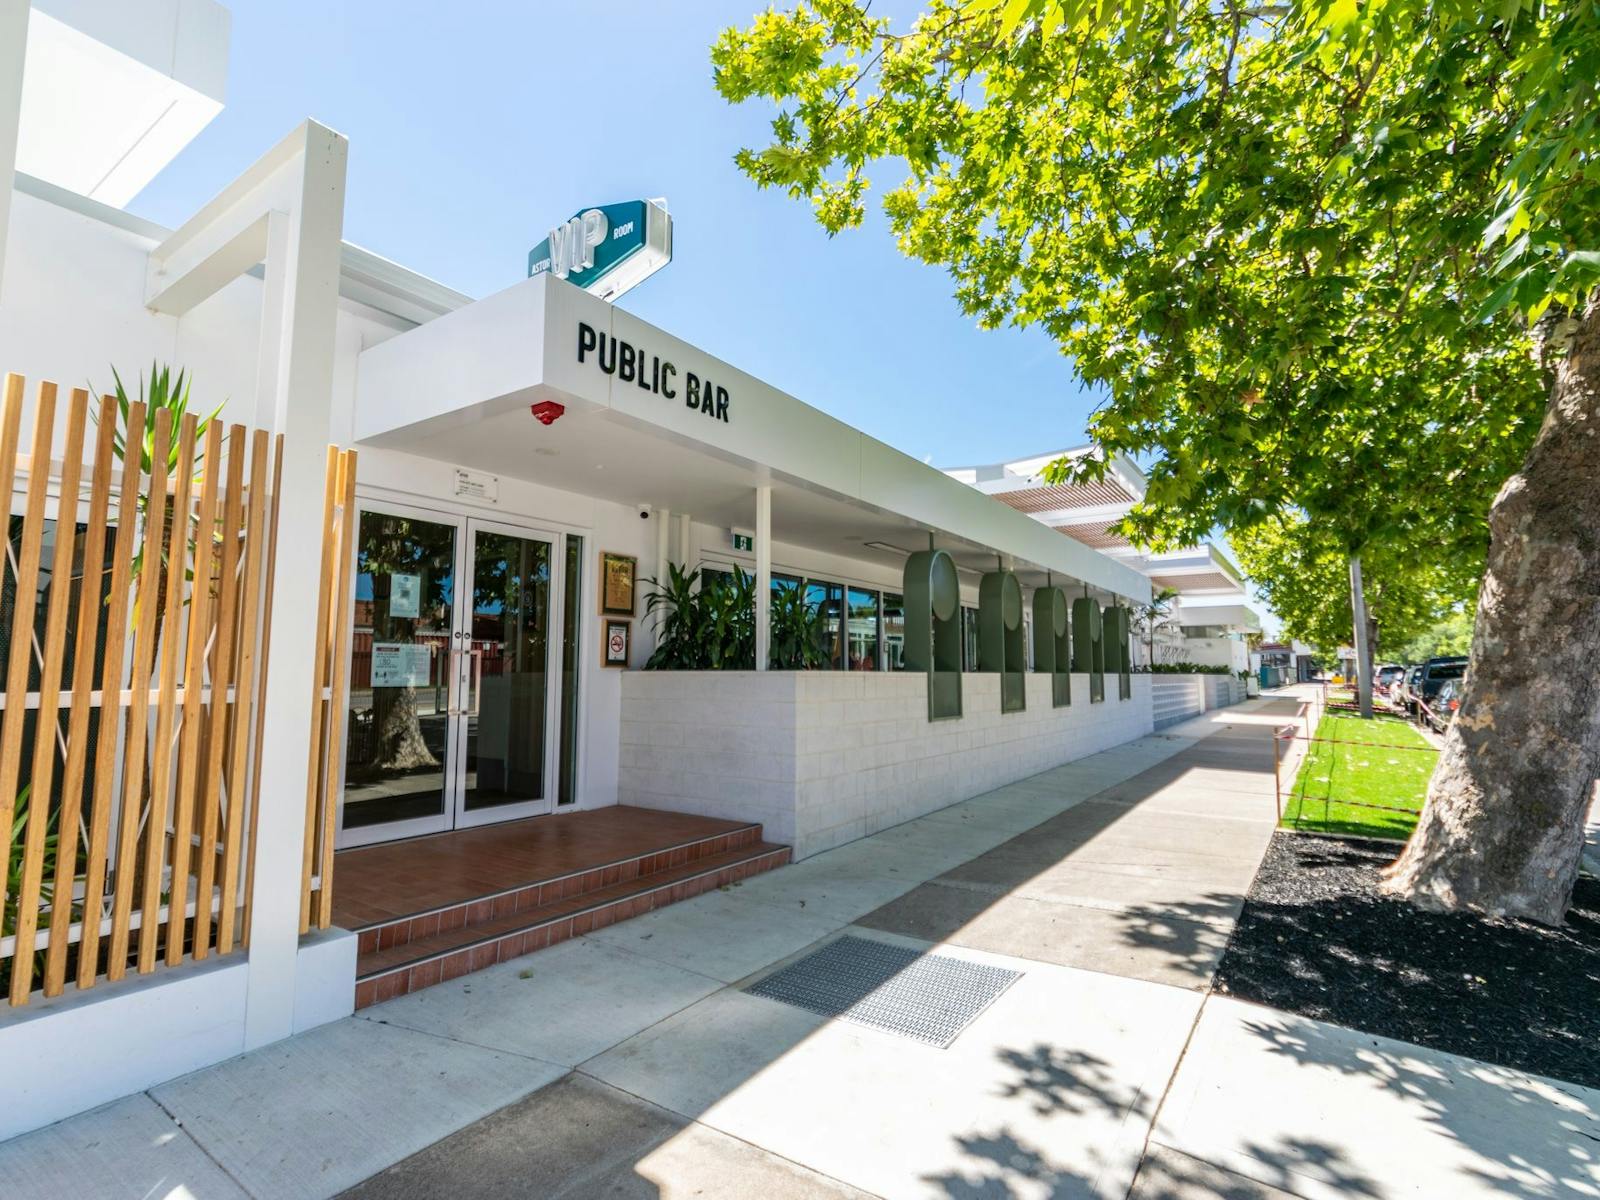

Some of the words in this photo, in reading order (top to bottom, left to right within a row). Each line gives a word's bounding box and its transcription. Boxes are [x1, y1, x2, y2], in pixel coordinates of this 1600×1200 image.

[531, 257, 551, 275] ASTOR
[549, 208, 608, 280] VIP
[613, 221, 634, 240] ROOM
[578, 322, 677, 399] PUBLIC
[686, 372, 729, 423] BAR
